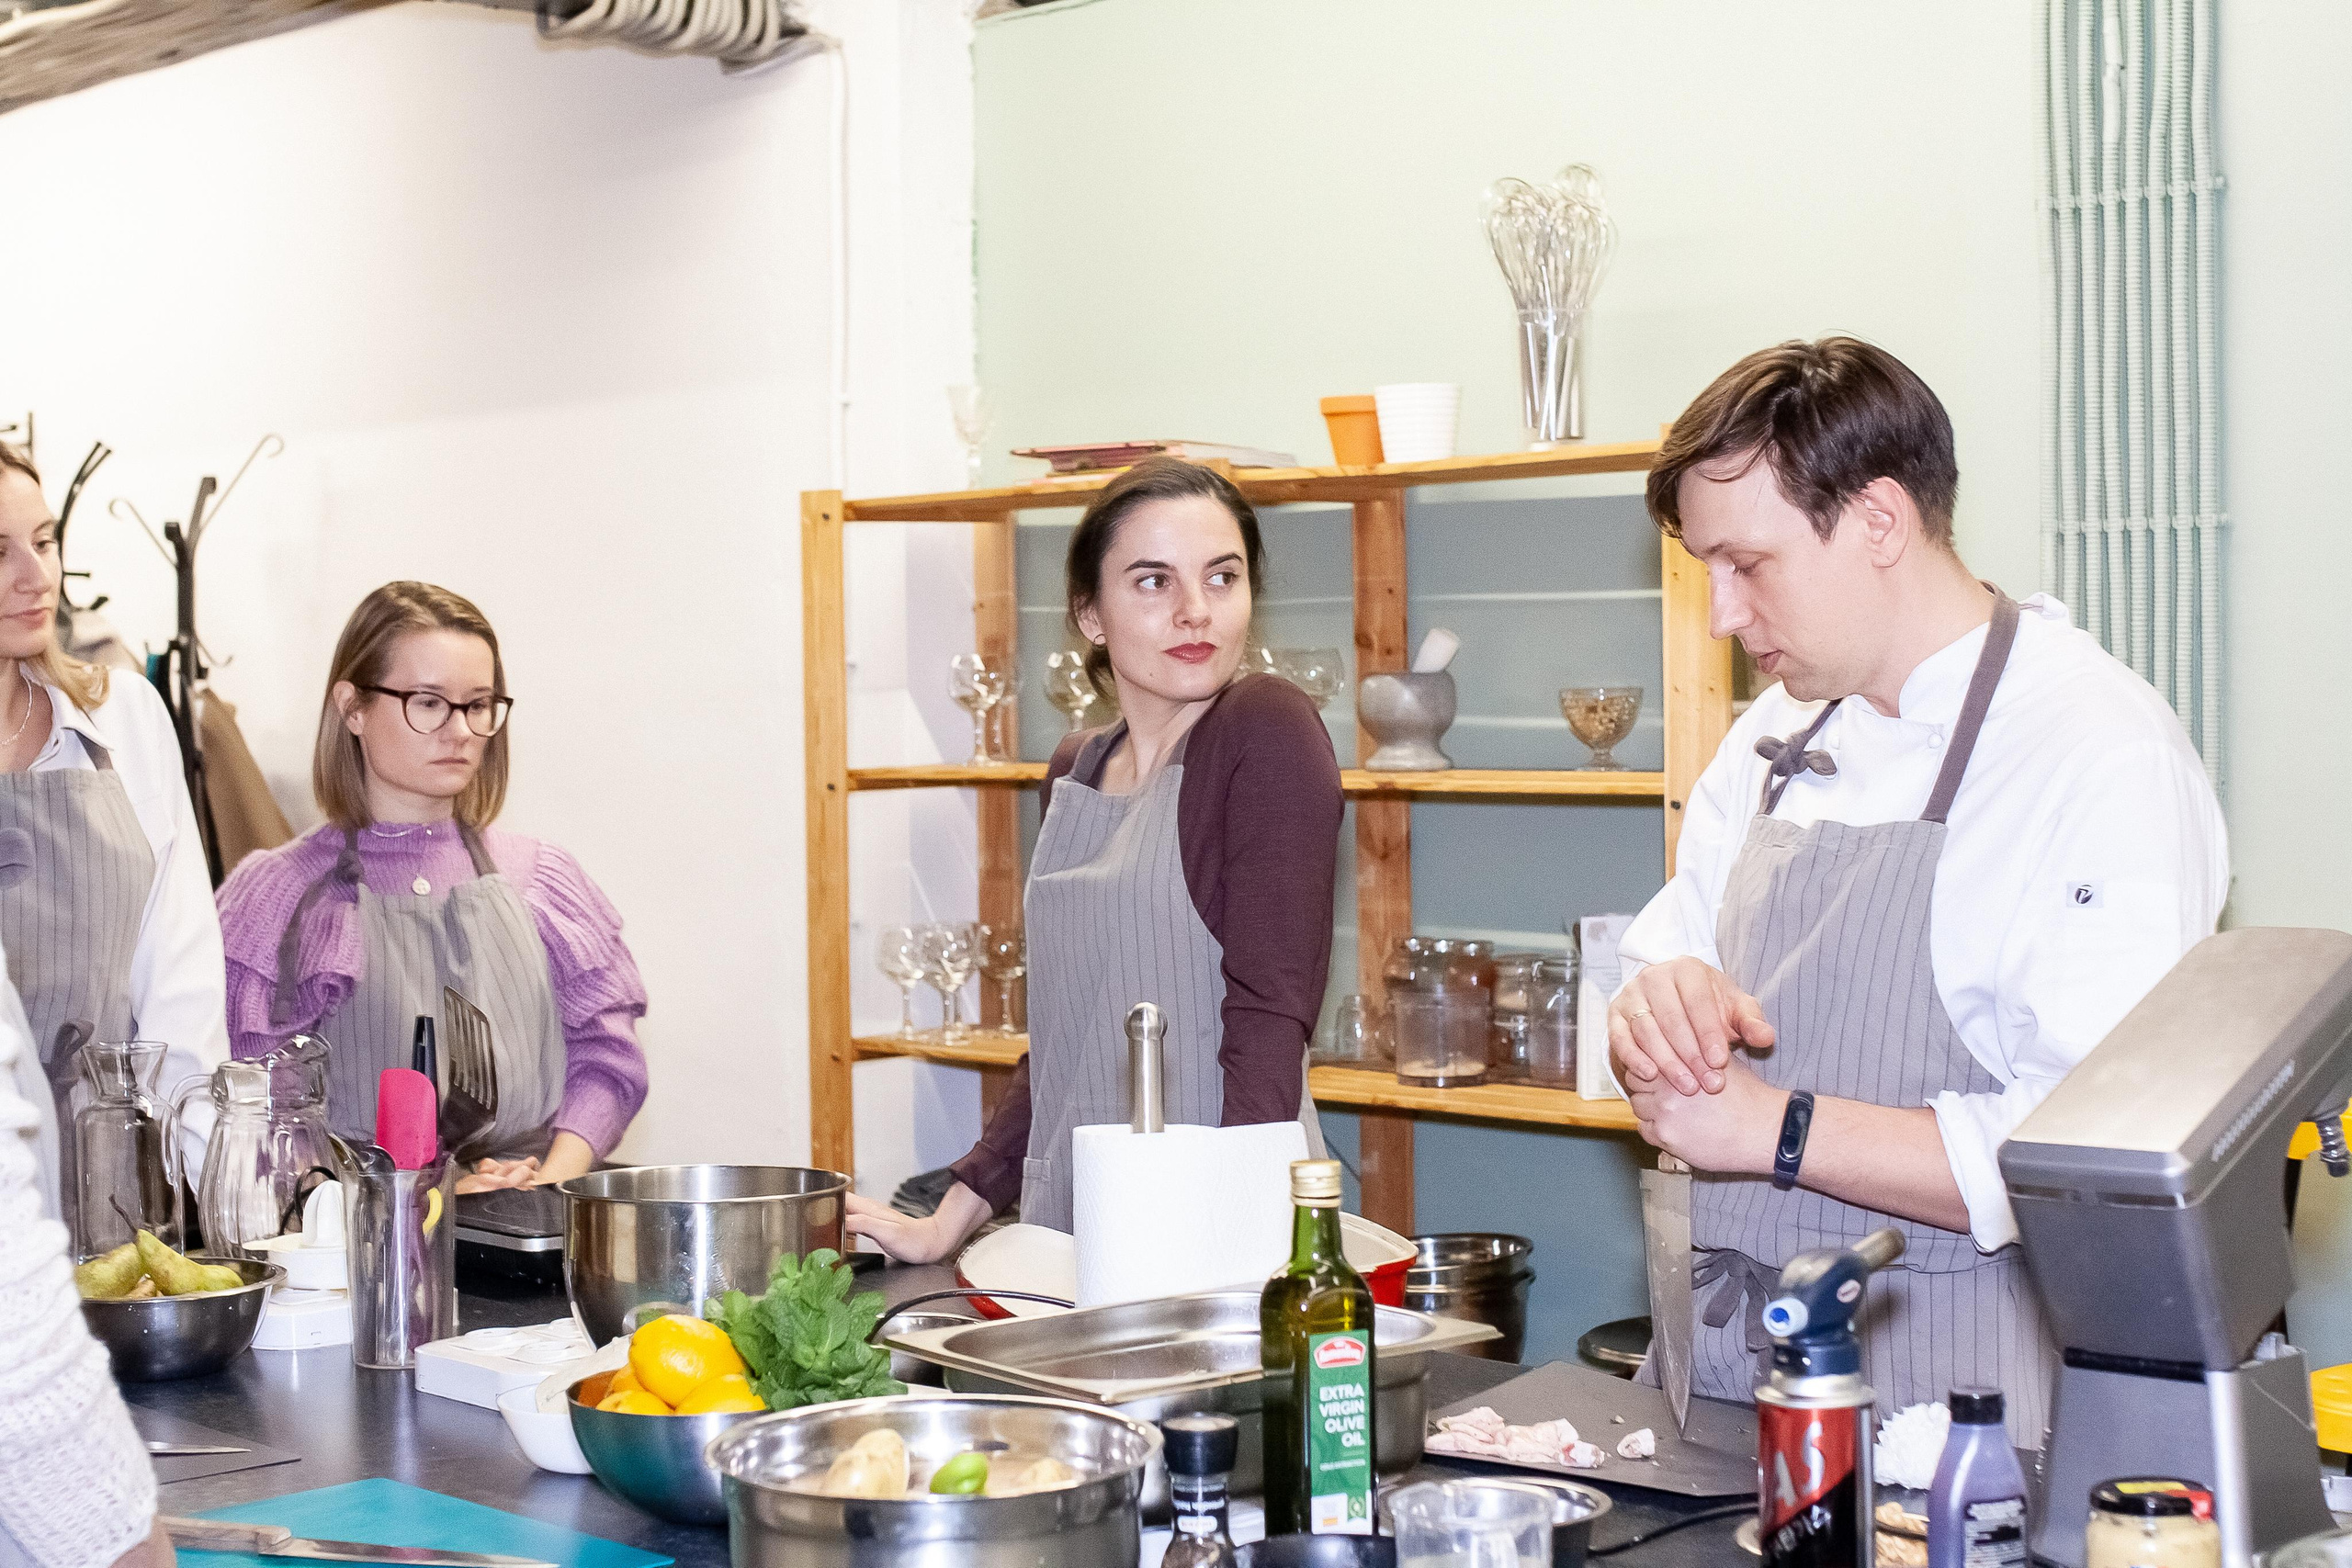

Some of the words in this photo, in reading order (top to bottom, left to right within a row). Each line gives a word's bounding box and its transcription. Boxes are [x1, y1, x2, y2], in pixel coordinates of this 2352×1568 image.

[1319, 1382, 1364, 1401] EXTRA
[1319, 1399, 1364, 1417] VIRGIN
[1325, 1416, 1364, 1433] OLIVE
[1342, 1432, 1364, 1447] OIL
